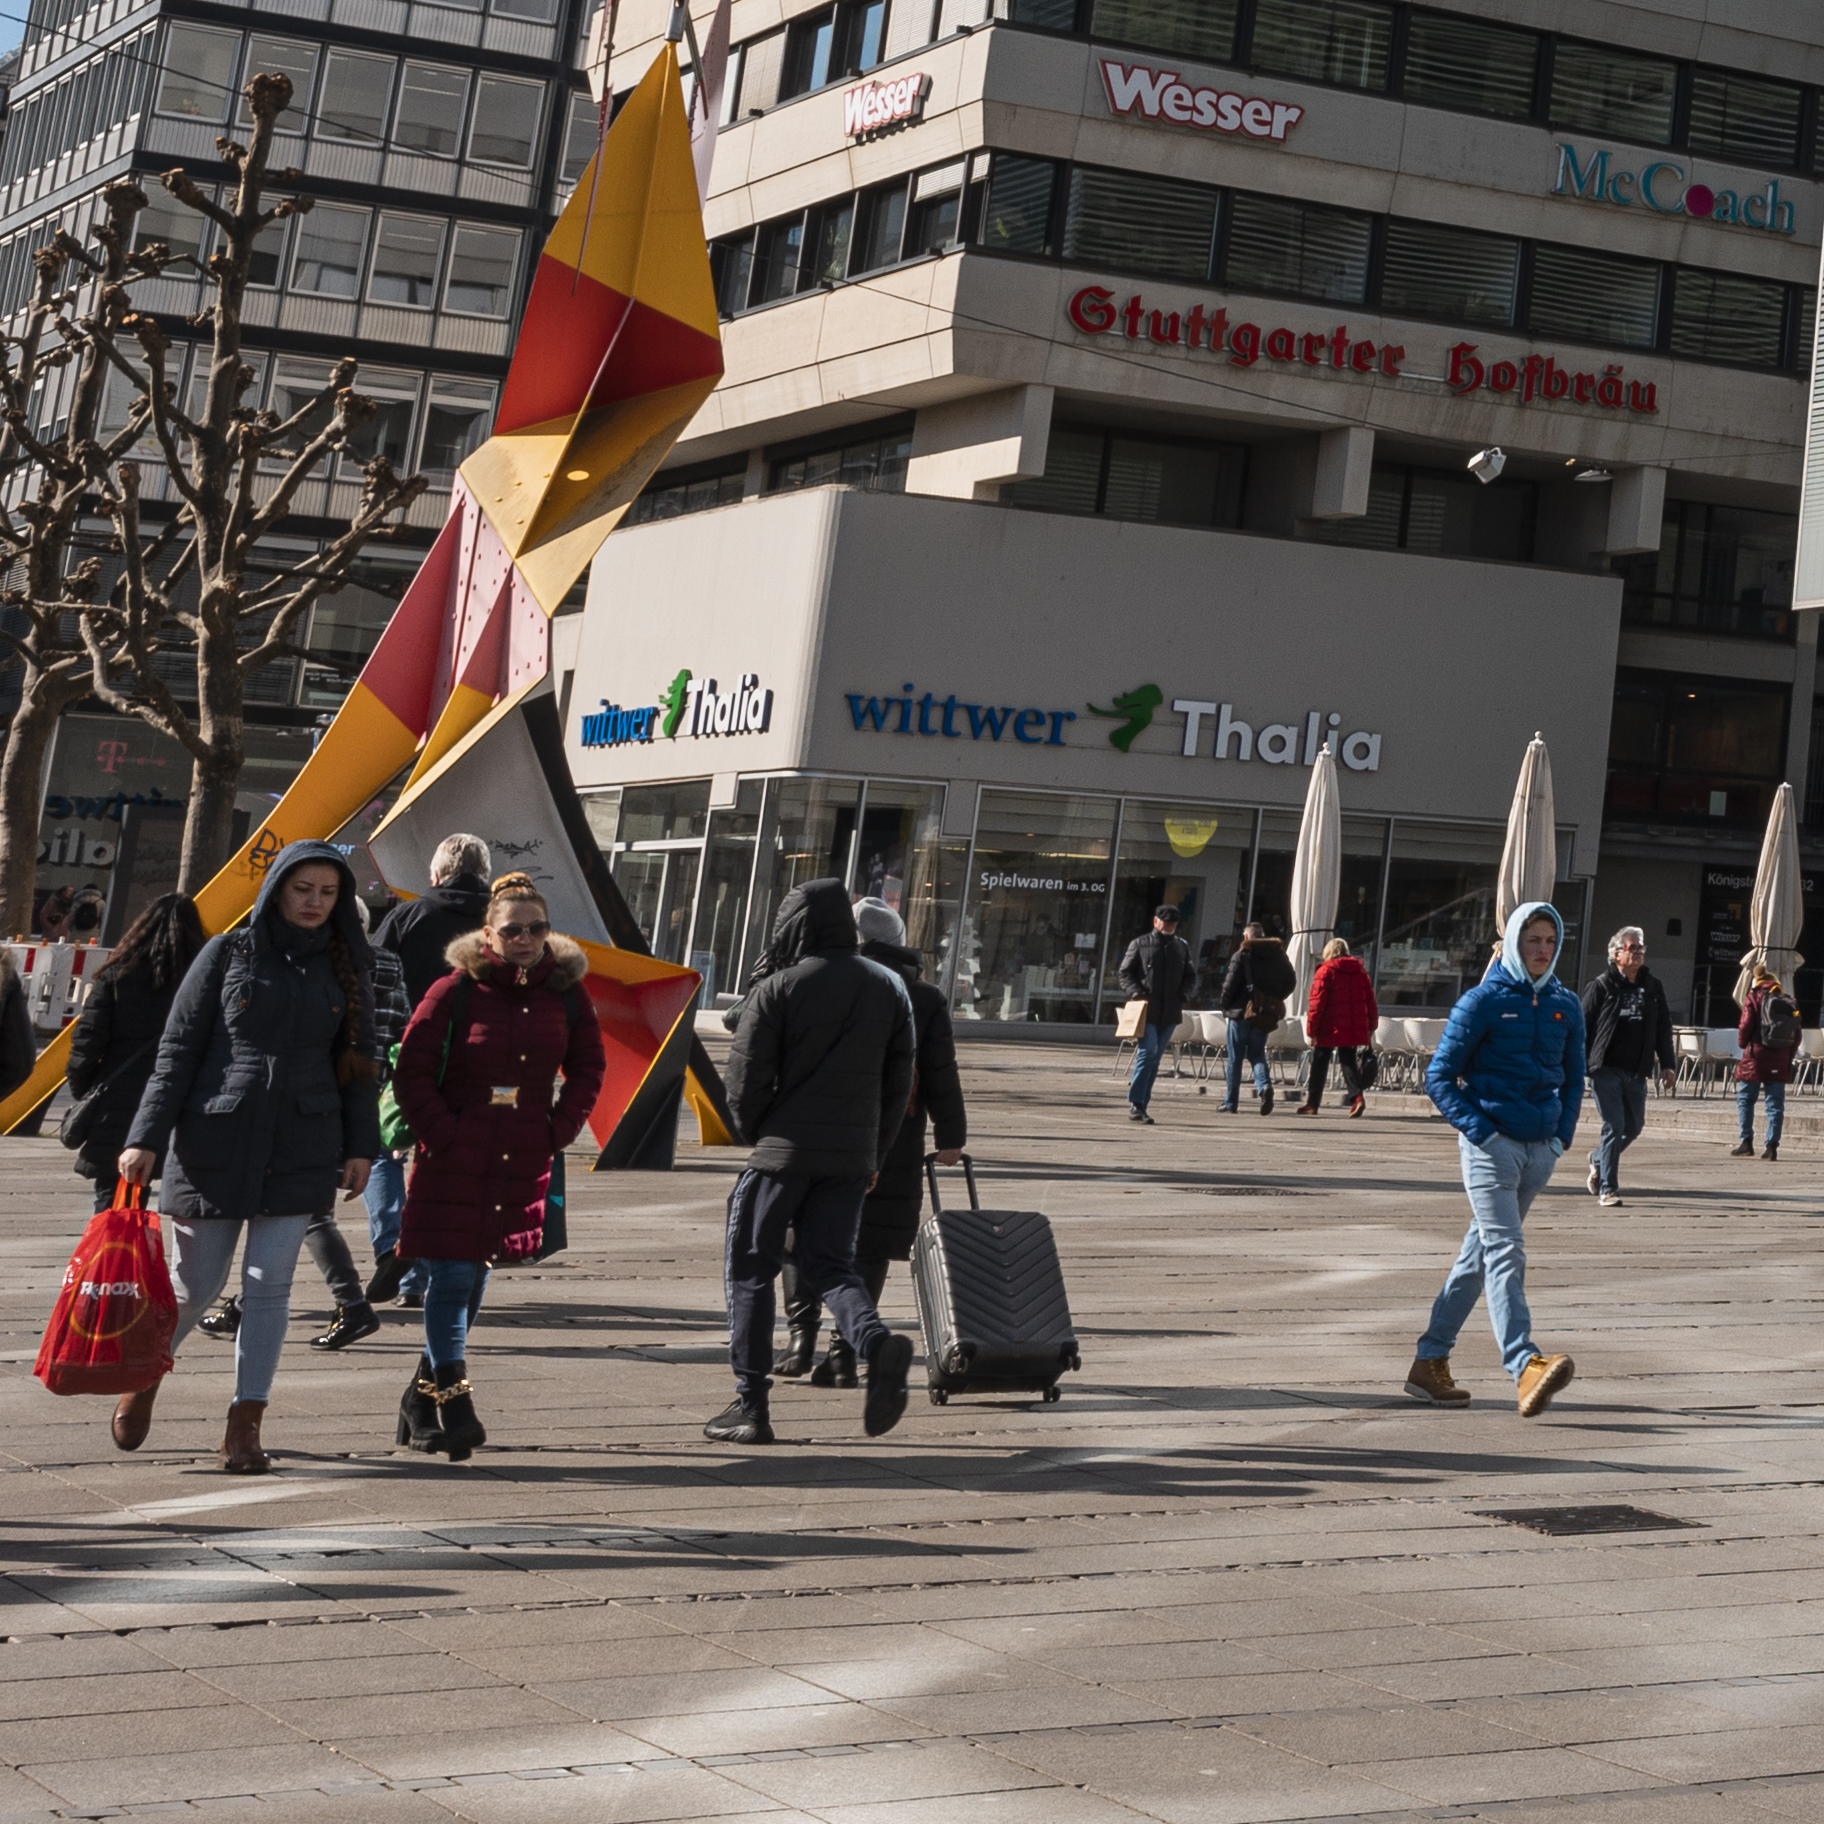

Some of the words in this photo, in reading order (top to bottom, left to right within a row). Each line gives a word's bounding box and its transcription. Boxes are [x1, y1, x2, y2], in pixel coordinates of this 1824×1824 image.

[844, 71, 930, 138] Wesser
[1099, 58, 1304, 143] Wesser
[1067, 285, 1406, 377] Stuttgarter
[1446, 340, 1659, 415] Hofbräu
[581, 699, 659, 749] wittwer
[686, 672, 773, 737] Thalia
[844, 682, 1077, 748] wittwer
[1172, 698, 1383, 771] Thalia
[980, 872, 1063, 890] Spielwaren
[1067, 881, 1078, 891] im
[1081, 883, 1089, 892] 3.
[1091, 883, 1105, 892] OG
